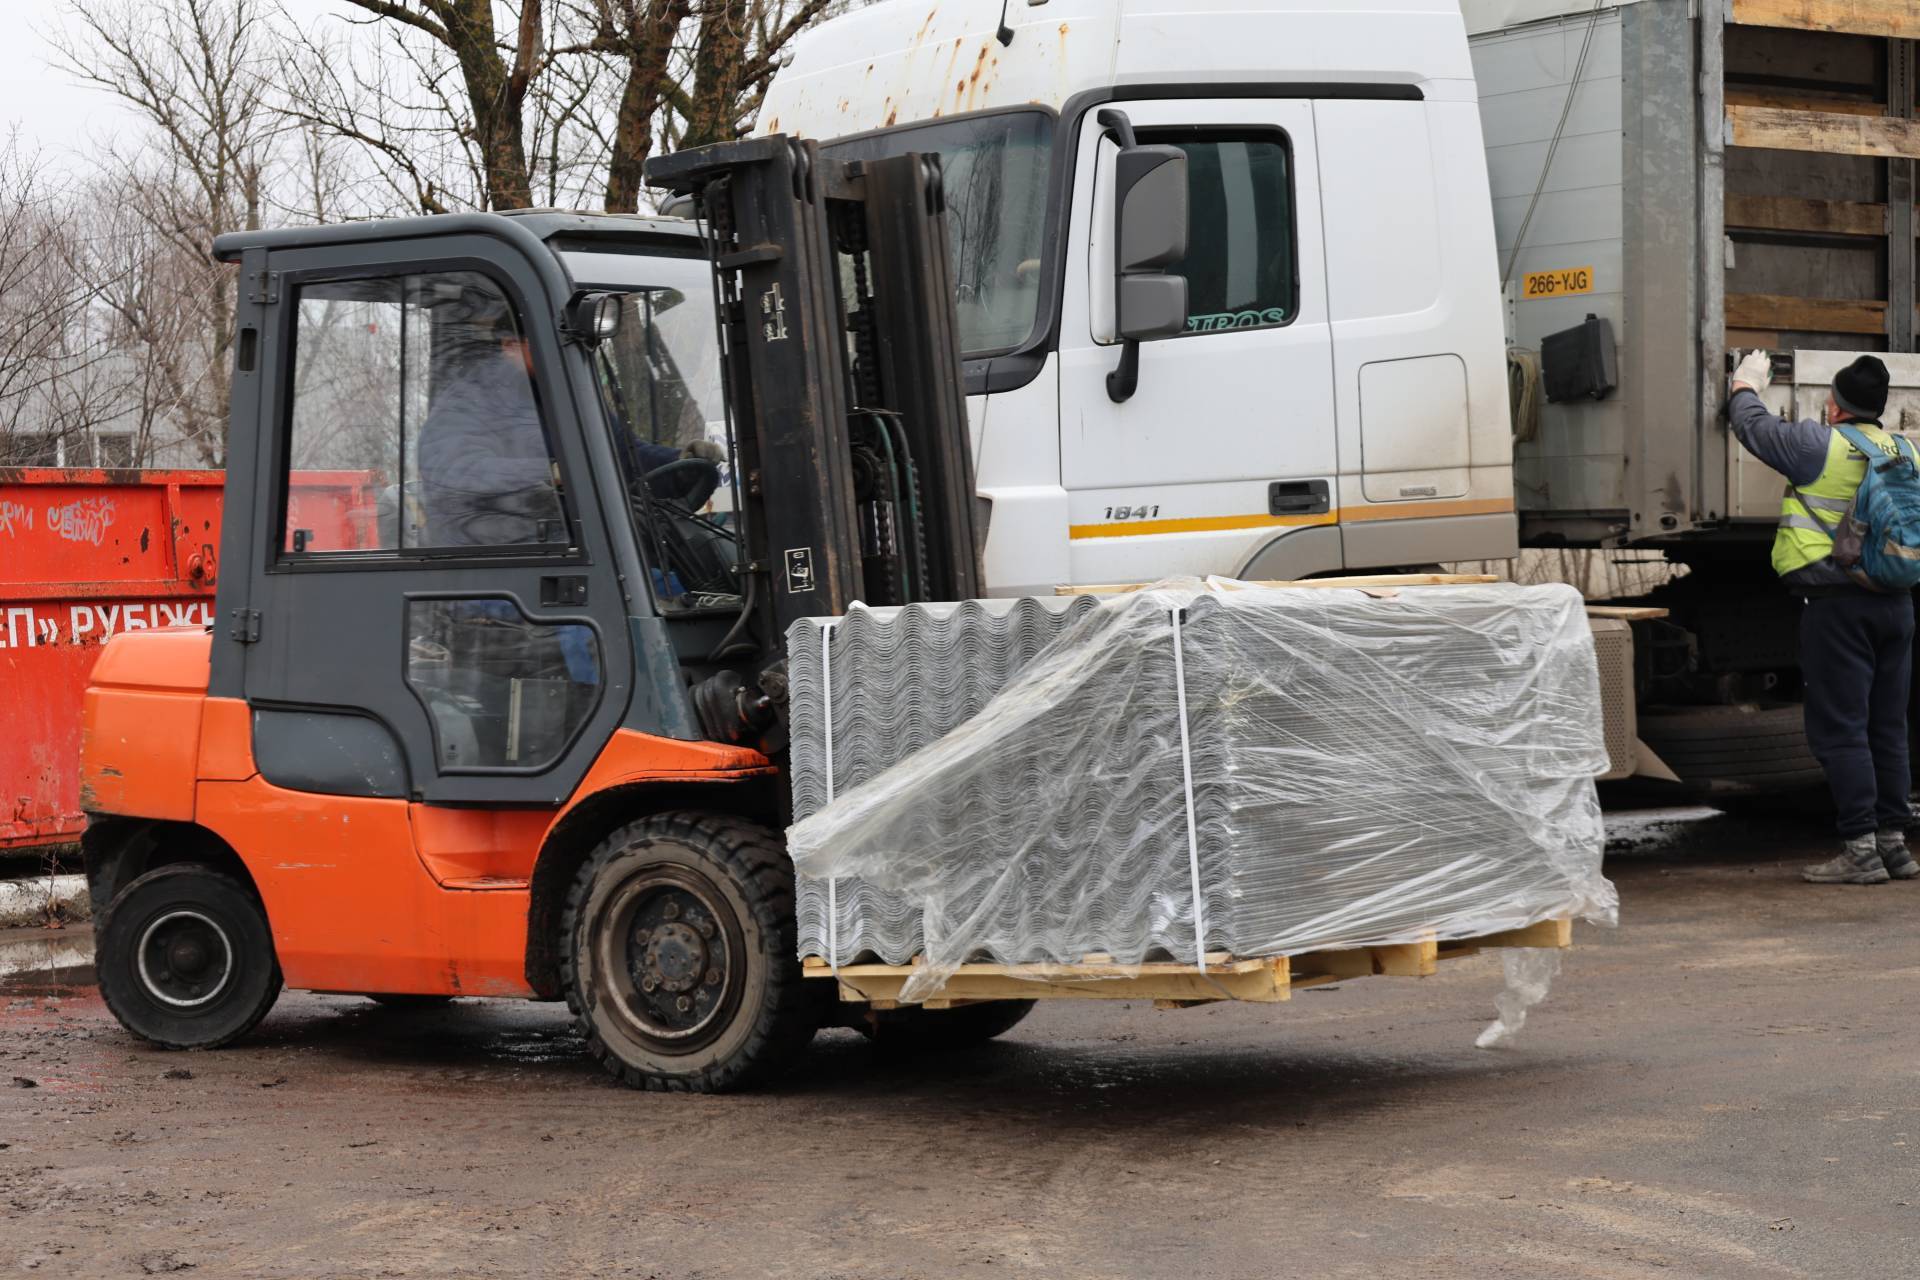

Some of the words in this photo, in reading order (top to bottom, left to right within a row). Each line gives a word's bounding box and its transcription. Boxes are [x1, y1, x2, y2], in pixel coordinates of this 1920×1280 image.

[1529, 270, 1587, 294] 266-YJG
[1104, 504, 1159, 520] 1841
[0, 607, 58, 648] П»
